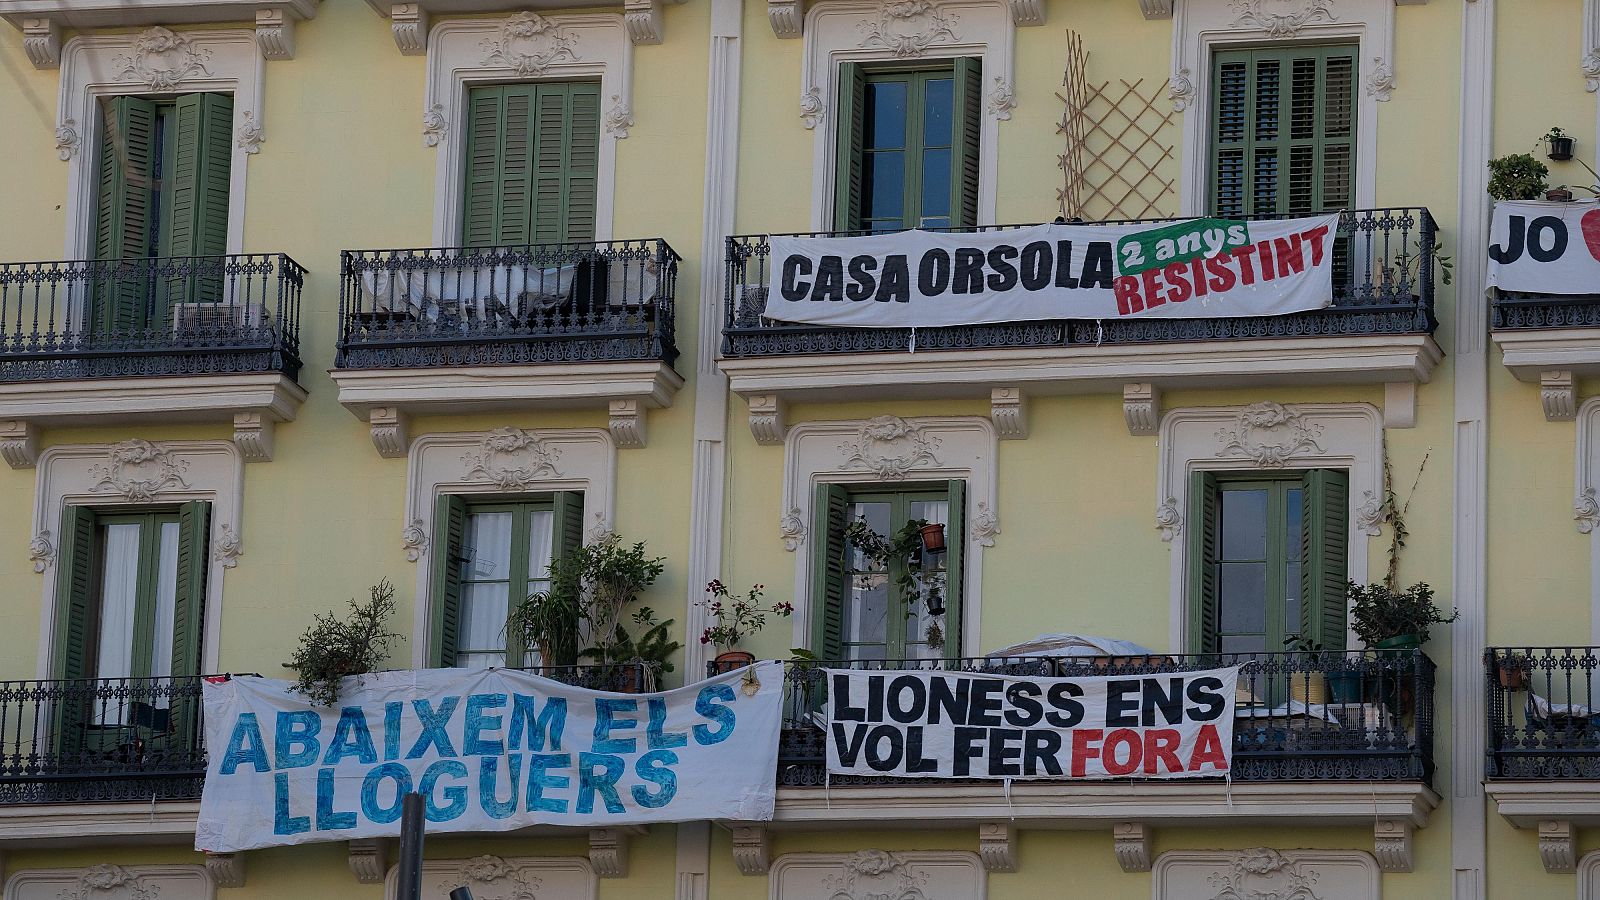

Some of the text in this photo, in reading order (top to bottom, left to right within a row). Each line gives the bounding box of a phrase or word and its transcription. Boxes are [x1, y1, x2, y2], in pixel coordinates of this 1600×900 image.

[1120, 221, 1248, 270] 2 anys
[1488, 215, 1569, 265] JO
[780, 239, 1114, 303] CASA ORSOLA
[1113, 225, 1329, 316] RESISTINT
[218, 683, 737, 775] ABAIXEM ELS
[832, 674, 1226, 728] LIONESS ENS
[832, 722, 1229, 777] VOL FER FORA
[273, 749, 679, 836] LLOGUERS
